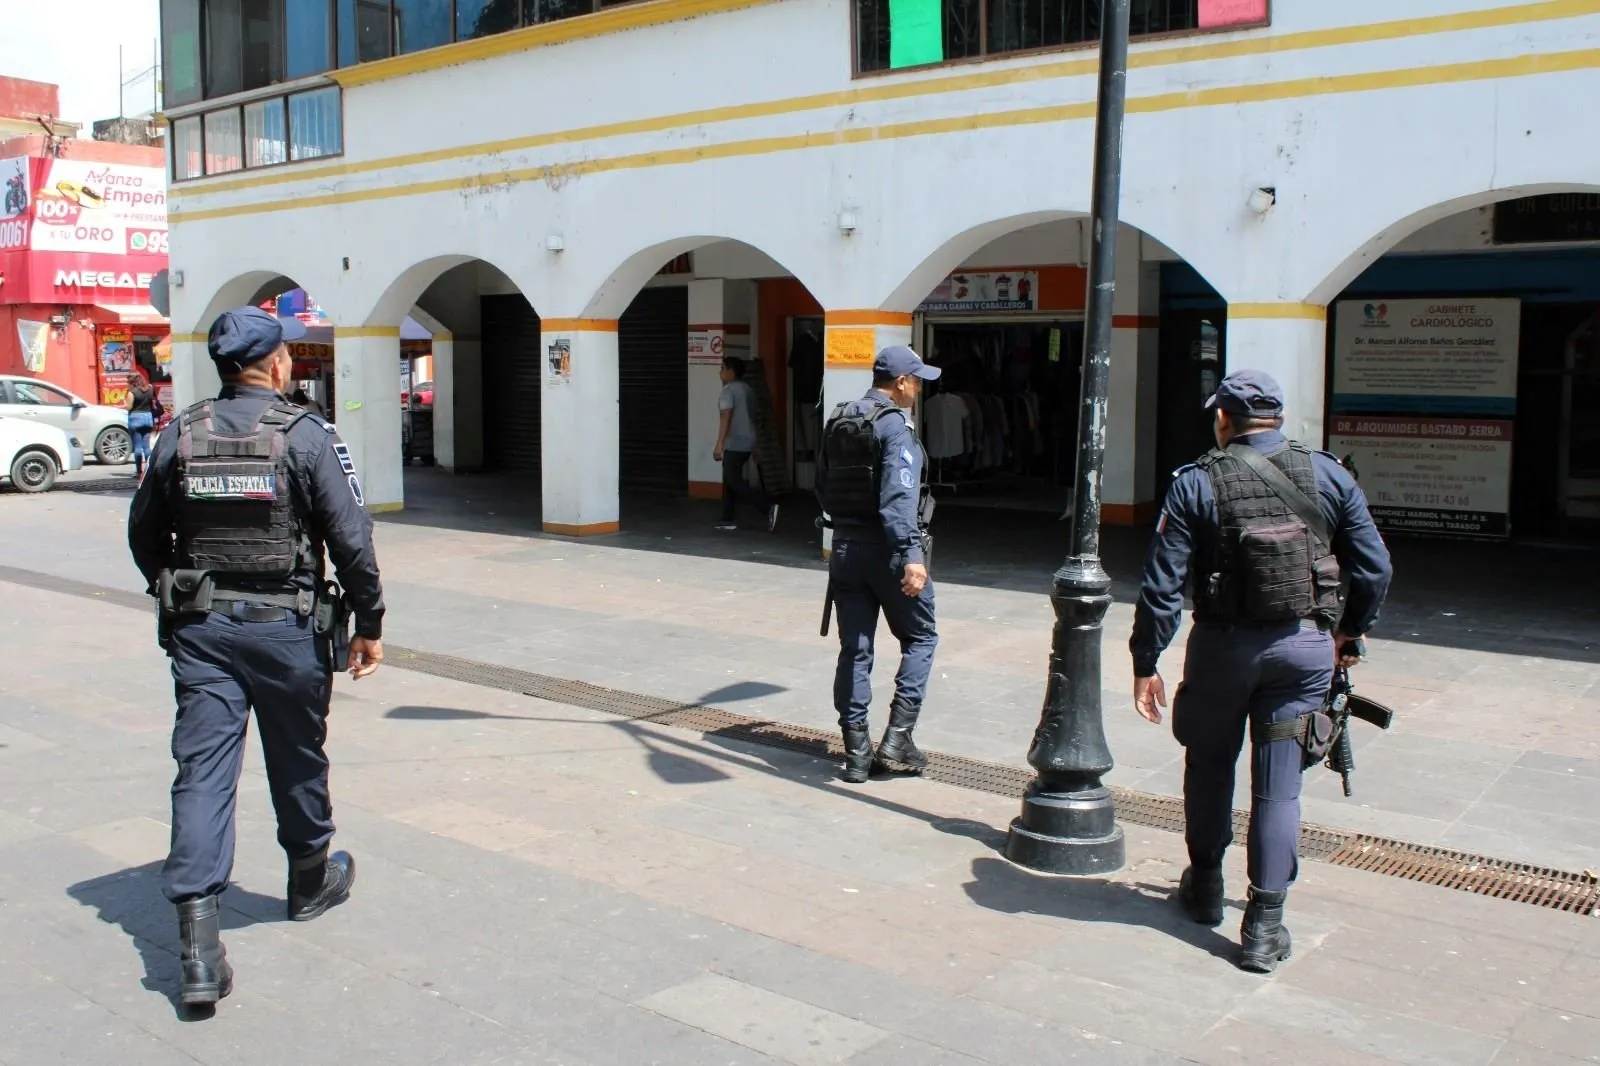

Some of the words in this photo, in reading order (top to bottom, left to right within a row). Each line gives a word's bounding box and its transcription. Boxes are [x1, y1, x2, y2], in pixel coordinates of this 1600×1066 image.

[85, 167, 143, 187] Avanza
[75, 226, 114, 242] ORO
[54, 269, 156, 289] MEGAE
[949, 302, 973, 311] DAMAS
[981, 300, 1026, 310] CABALLEROS
[1428, 304, 1477, 314] GABINETE
[1354, 337, 1366, 345] Dr.
[1368, 337, 1396, 345] Manuel
[1398, 337, 1428, 345] Alfonso
[1337, 421, 1353, 432] DR.
[1356, 422, 1419, 434] ARQUIMIDES
[1468, 425, 1501, 437] SERRA
[187, 476, 225, 493] POLICIA
[227, 475, 272, 493] ESTATAL
